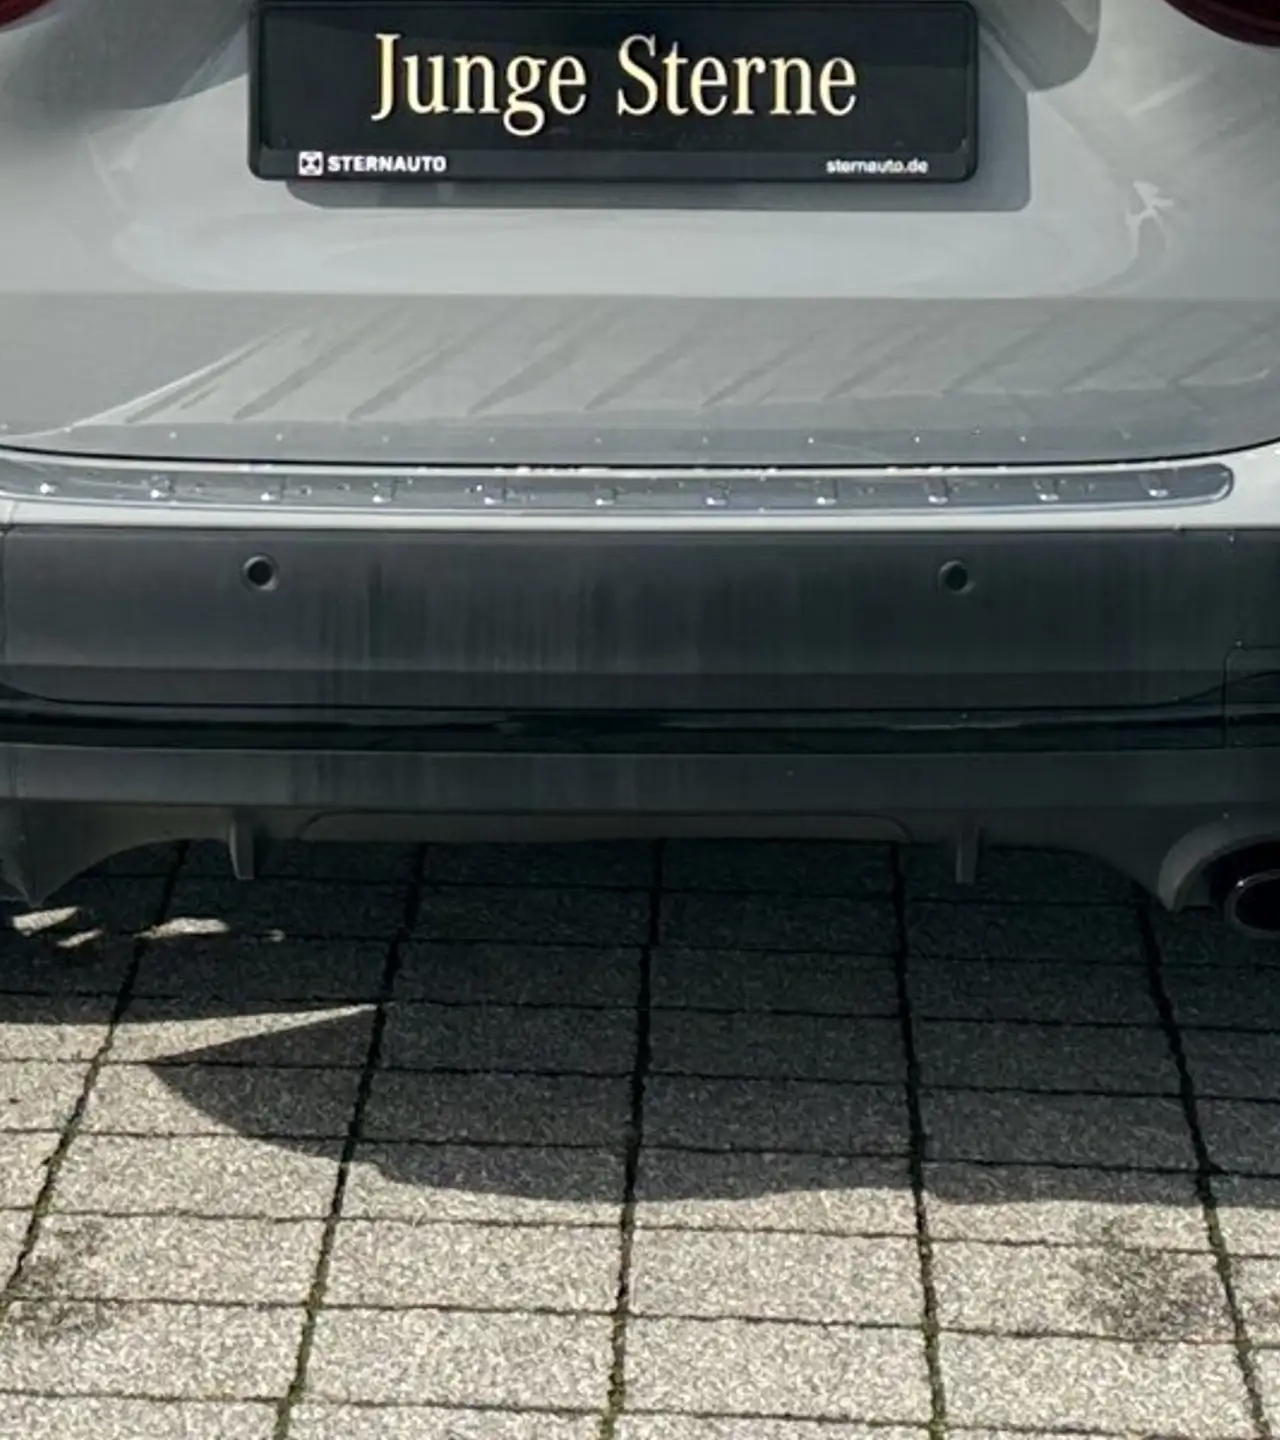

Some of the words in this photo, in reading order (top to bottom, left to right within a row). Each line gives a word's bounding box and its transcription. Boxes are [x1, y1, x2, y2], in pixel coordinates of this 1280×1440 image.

[370, 33, 587, 137] Junge
[617, 34, 857, 117] Sterne
[327, 155, 447, 173] STERNAUTO
[826, 159, 928, 174] sternauto.de
